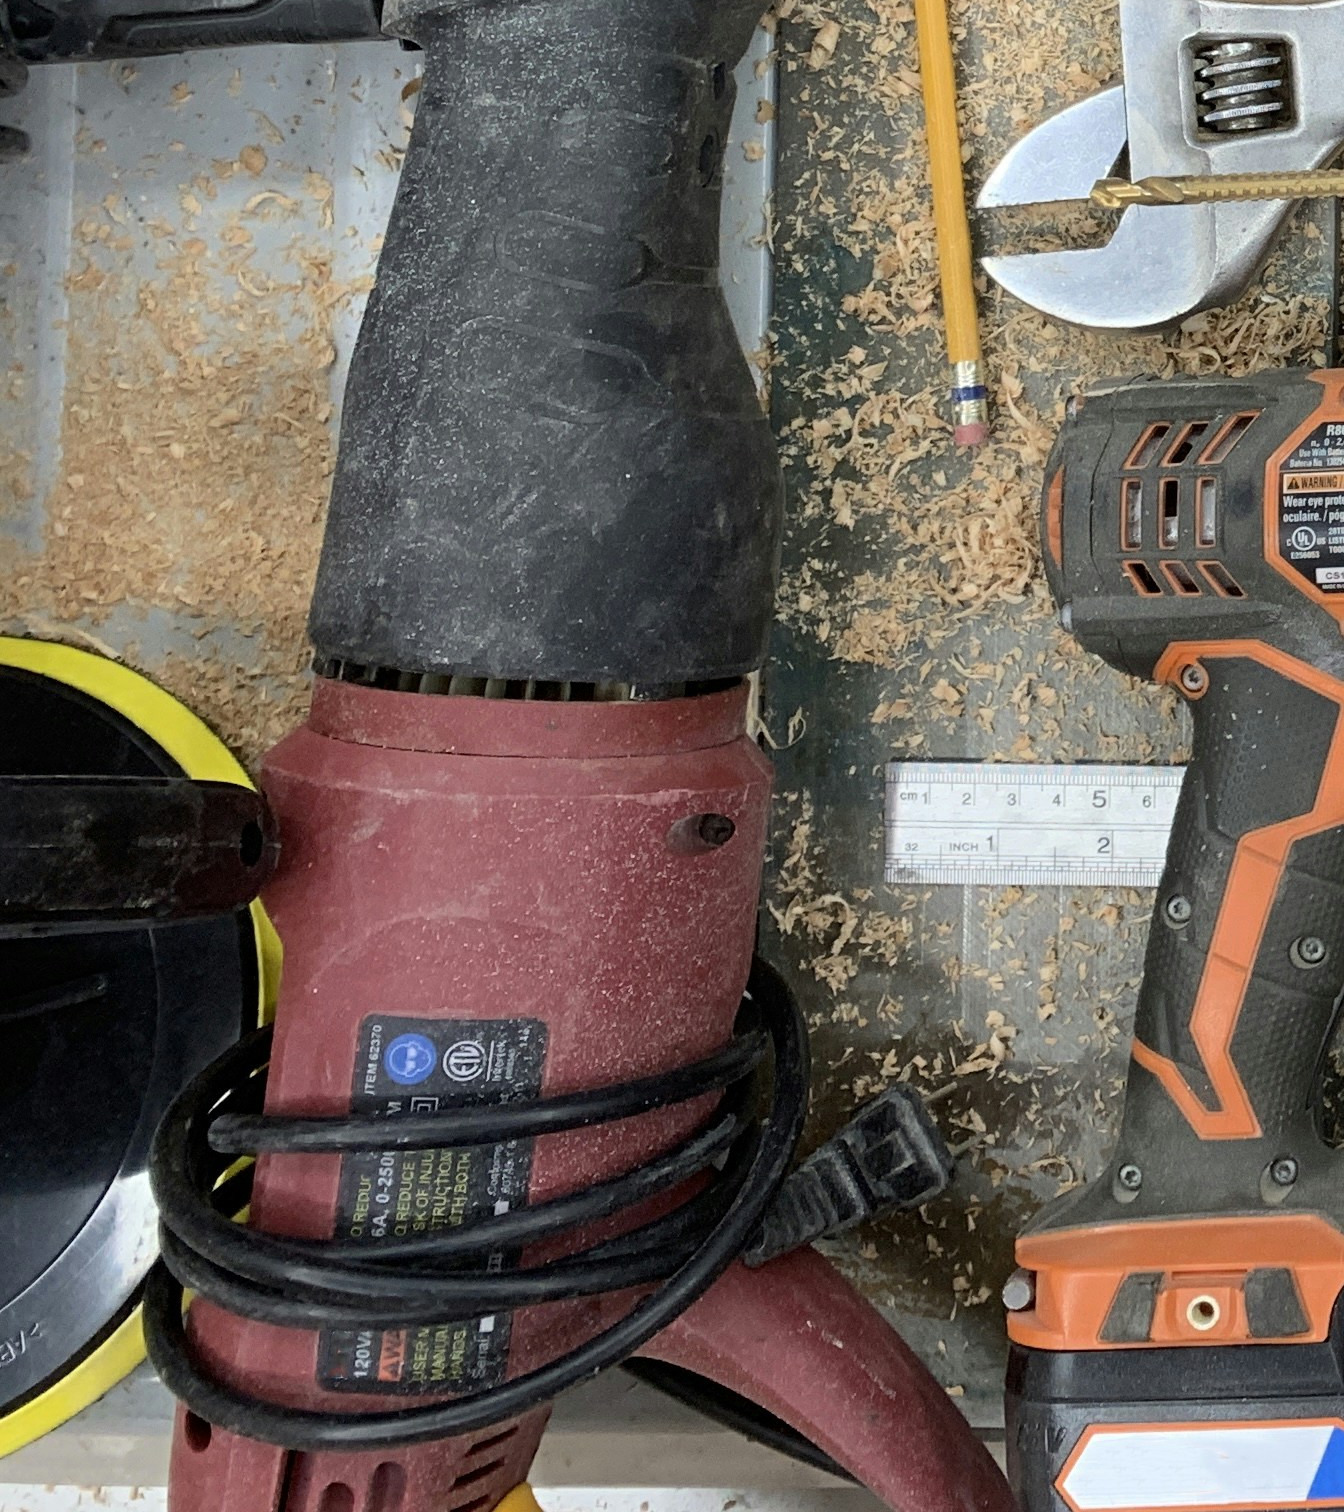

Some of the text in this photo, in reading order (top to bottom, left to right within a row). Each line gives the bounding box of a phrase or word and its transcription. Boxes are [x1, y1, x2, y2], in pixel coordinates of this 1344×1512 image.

[1301, 475, 1338, 489] WARNING
[1283, 495, 1306, 508] Wear
[1308, 497, 1323, 508] eye
[1283, 509, 1322, 523] oculaire.
[899, 791, 918, 801] cm
[962, 792, 972, 805] 2
[1007, 793, 1017, 806] 3
[1052, 793, 1062, 806] 4
[1092, 790, 1107, 808] 5
[1142, 794, 1152, 808] 6
[904, 842, 919, 852] 32
[949, 841, 979, 852] INCH
[1097, 837, 1111, 853] 2
[363, 1024, 382, 1096] ITEM 62370
